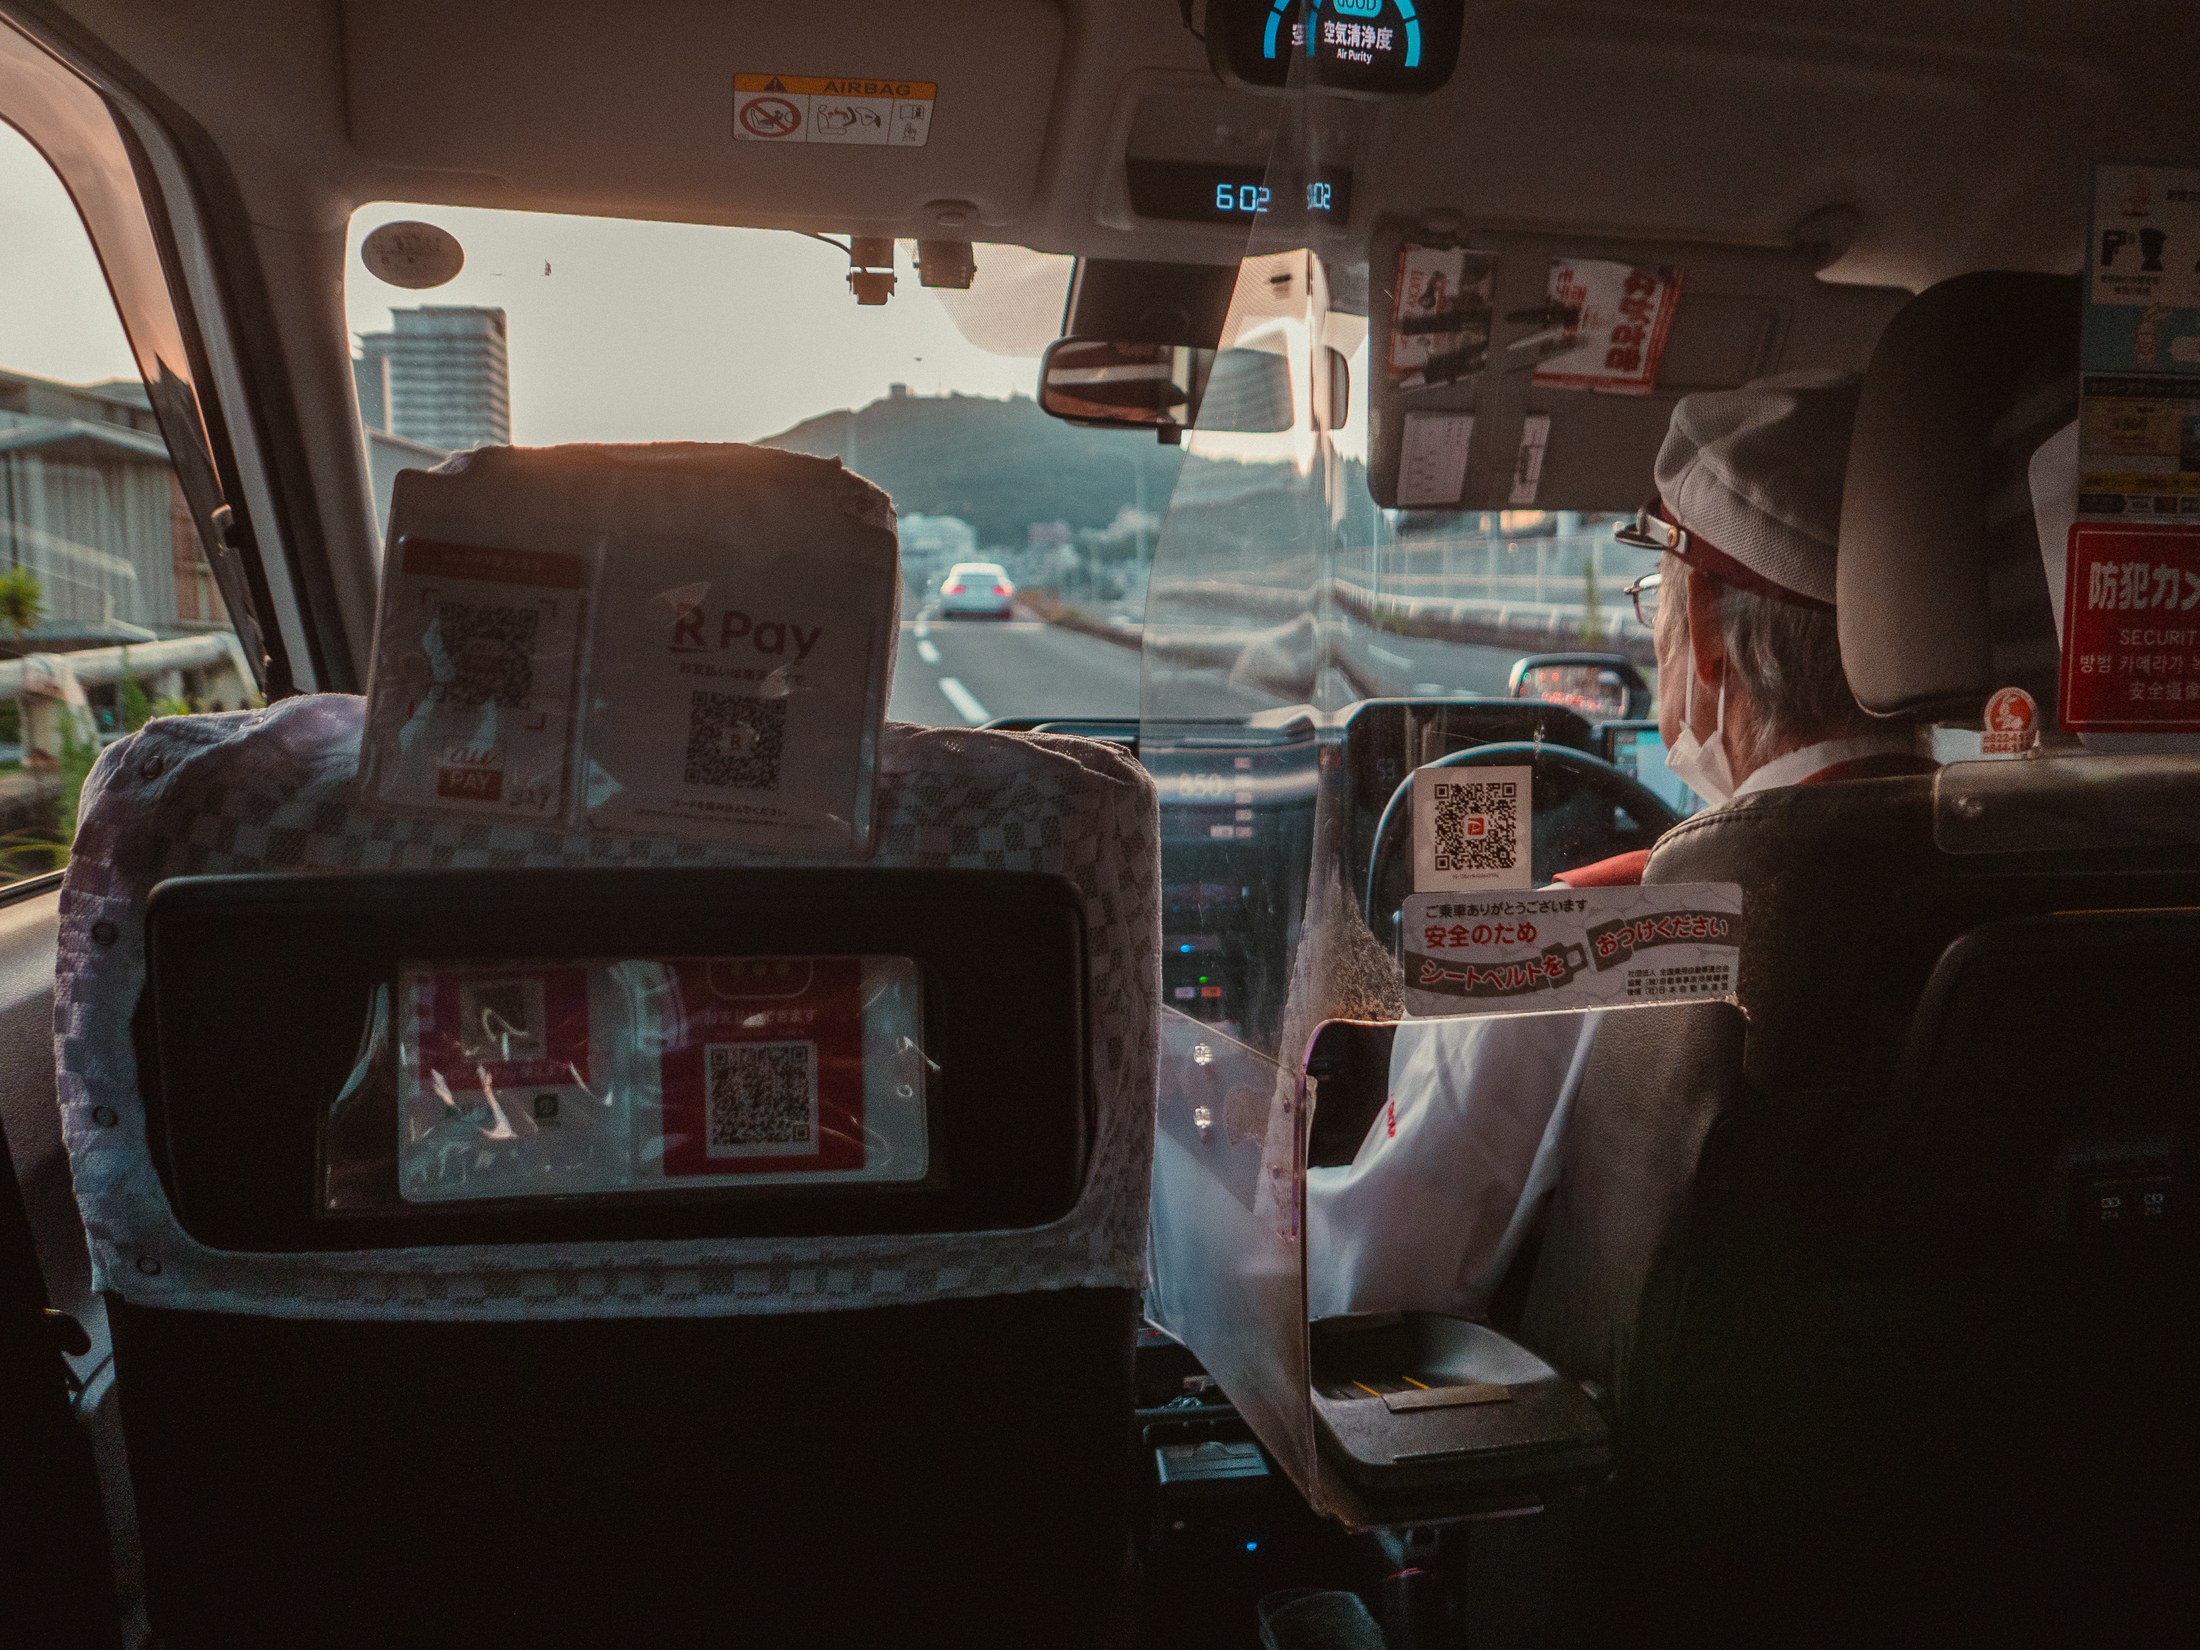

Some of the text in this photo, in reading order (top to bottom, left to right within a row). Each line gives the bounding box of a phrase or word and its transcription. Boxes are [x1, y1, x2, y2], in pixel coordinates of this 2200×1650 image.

[1323, 20, 1393, 51] 空気清浄度
[1336, 48, 1373, 64] Air Purity
[823, 80, 911, 96] AIRBAG
[673, 602, 823, 666] R Pay
[2120, 629, 2200, 646] SECURIT
[2079, 654, 2113, 674] 방범
[449, 771, 492, 792] PAY
[1425, 899, 1587, 919] ご乗車ありがとうございます
[1424, 921, 1538, 949] 安全のため
[1595, 914, 1729, 957] おつけください
[1420, 954, 1566, 991] シートベルトを
